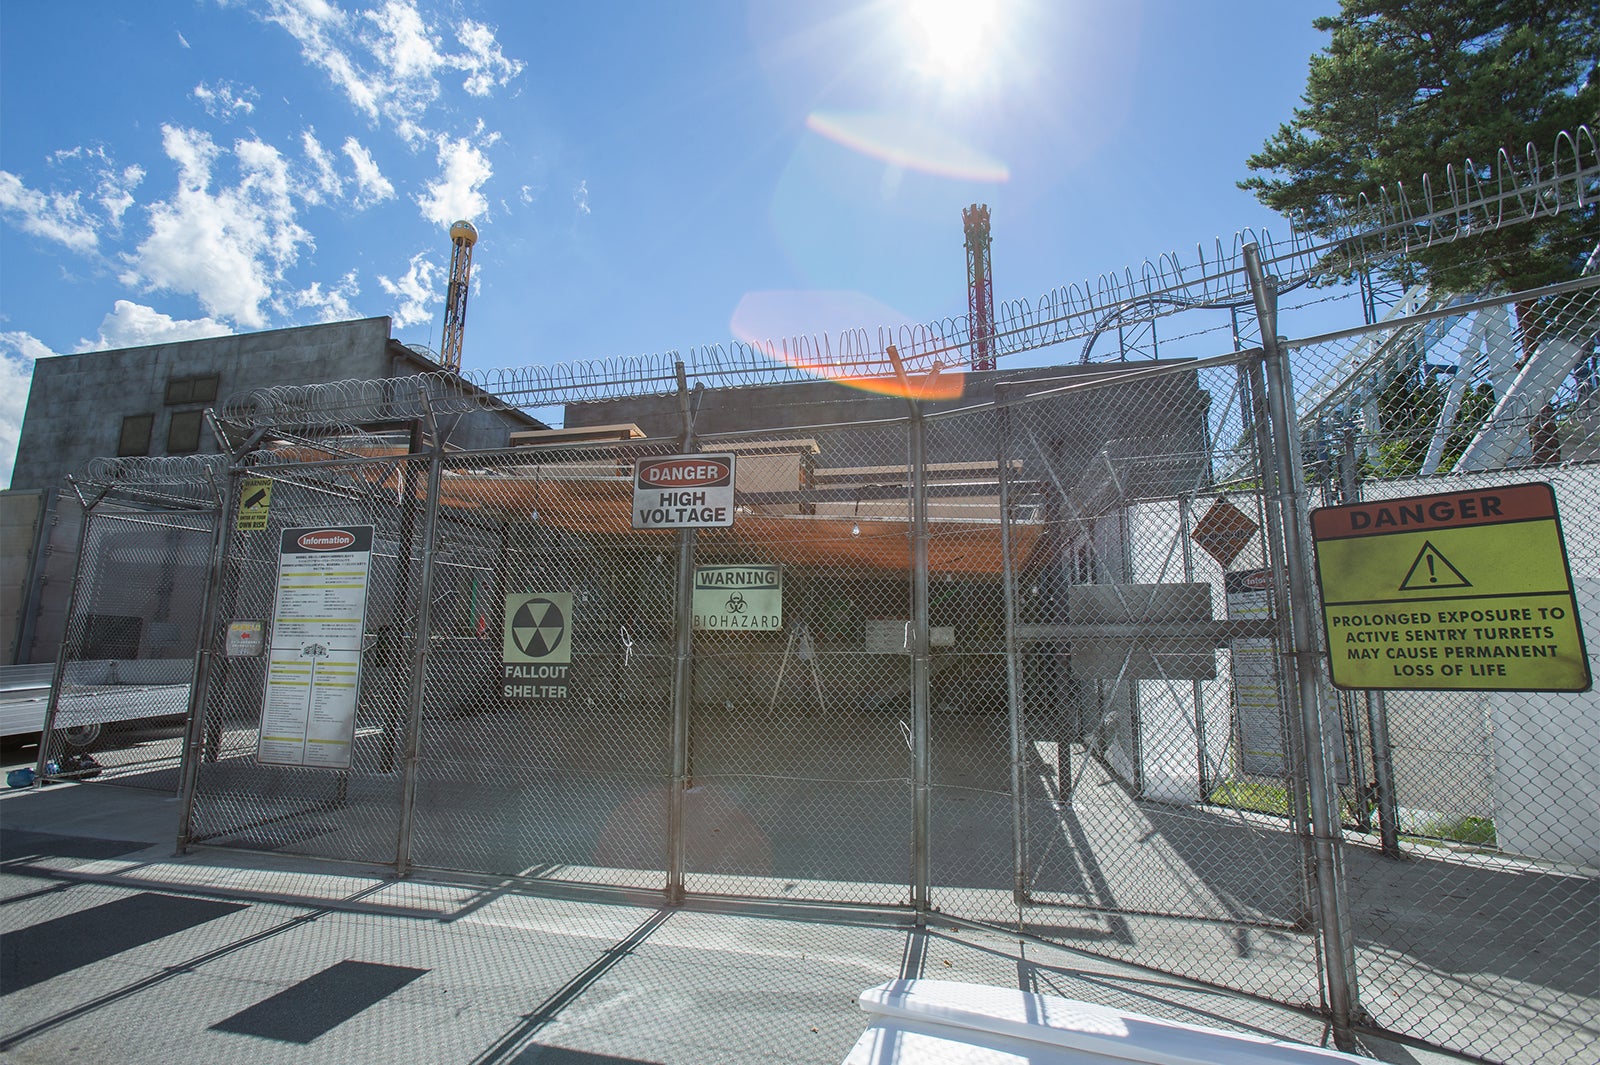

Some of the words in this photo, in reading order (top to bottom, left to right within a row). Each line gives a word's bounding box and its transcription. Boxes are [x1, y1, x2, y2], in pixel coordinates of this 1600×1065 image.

[649, 465, 719, 481] DANGER
[659, 491, 706, 507] HIGH
[639, 507, 727, 524] VOLTAGE
[1350, 496, 1504, 530] DANGER
[303, 536, 350, 545] Information
[700, 571, 776, 585] WARNING
[694, 615, 779, 628] BIOHAZARD
[1331, 612, 1432, 627] PROLONGED
[1438, 607, 1532, 624] EXPOSURE
[1538, 606, 1565, 620] TO
[1345, 630, 1400, 643] ACTIVE
[1405, 628, 1468, 642] SENTRY
[1474, 626, 1554, 640] TURRETS
[1347, 648, 1381, 660] MAY
[1387, 646, 1438, 659] CAUSE
[1444, 644, 1558, 658] PERMANENT
[505, 665, 568, 679] FALLOUT
[1393, 664, 1434, 677] LOSS
[1441, 664, 1464, 677] OF
[1470, 663, 1507, 676] LIFE
[504, 685, 567, 698] SHELTER
